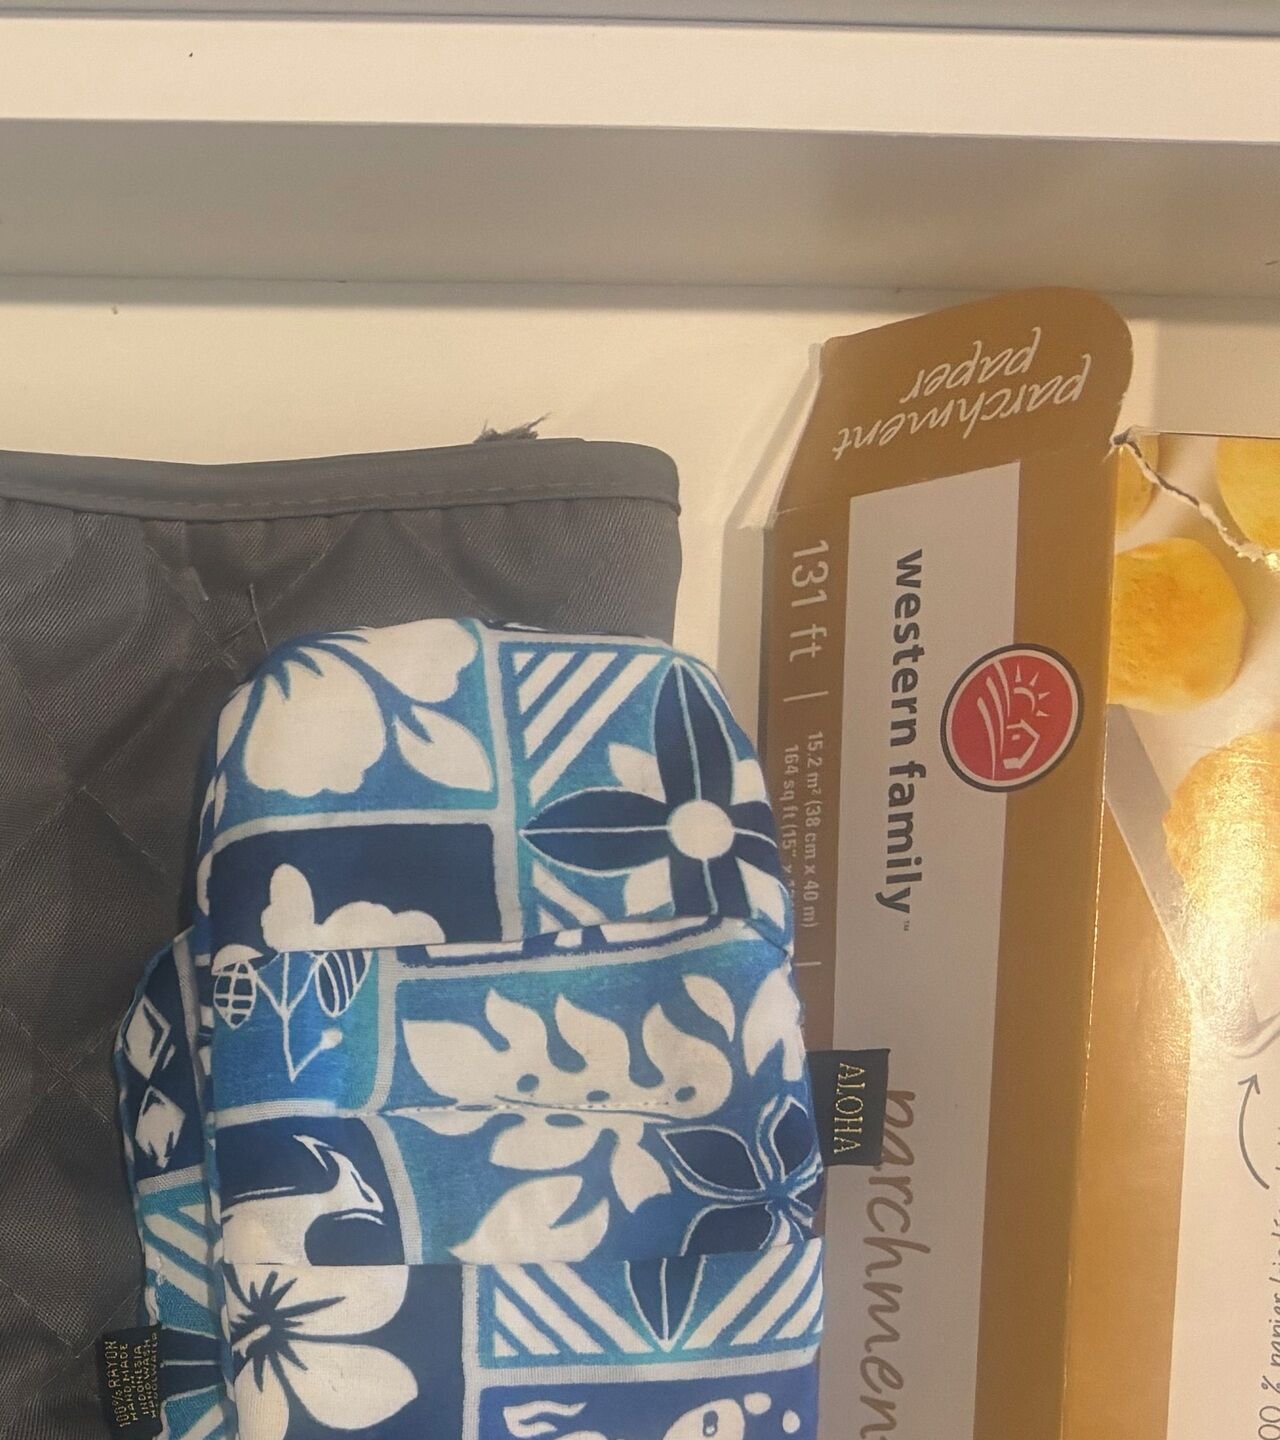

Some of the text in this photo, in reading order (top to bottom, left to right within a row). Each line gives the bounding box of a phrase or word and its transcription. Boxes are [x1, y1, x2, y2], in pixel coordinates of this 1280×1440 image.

[899, 326, 1042, 404] paper
[832, 353, 1092, 462] parchment
[788, 540, 830, 663] 131 ft
[807, 731, 824, 768] 15.2
[874, 548, 927, 914] western family
[780, 744, 799, 820] 164 sq ft
[803, 800, 822, 827] (38
[804, 832, 818, 859] cm
[803, 880, 819, 901] 40
[804, 863, 814, 875] x
[801, 905, 818, 928] m)
[833, 1062, 866, 1155] ALOHA
[104, 1340, 121, 1388] RAYON
[119, 1343, 130, 1382] MADE
